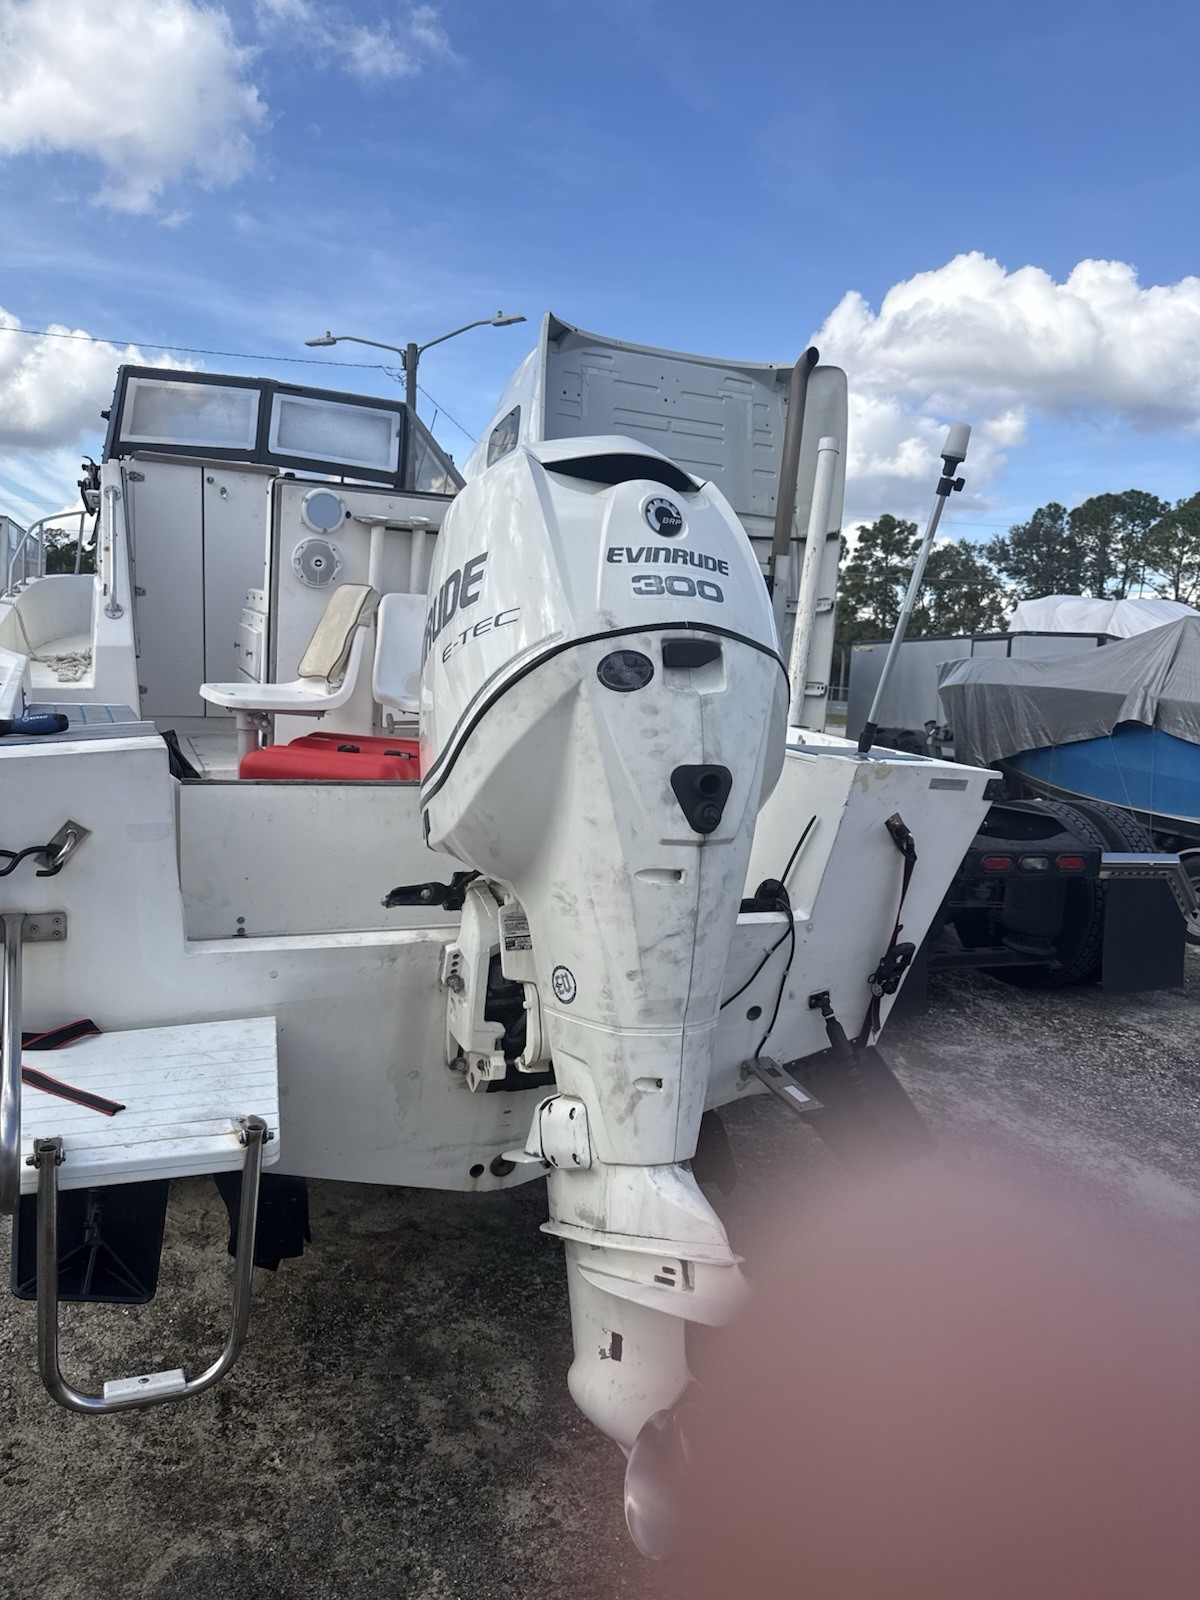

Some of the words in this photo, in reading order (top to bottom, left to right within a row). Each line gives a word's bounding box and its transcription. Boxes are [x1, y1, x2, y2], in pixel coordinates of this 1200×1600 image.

[661, 516, 682, 526] BRP
[606, 546, 729, 576] EVINRUDE
[630, 574, 725, 603] 300
[421, 551, 489, 664] RUDE
[442, 606, 522, 664] E-TEC
